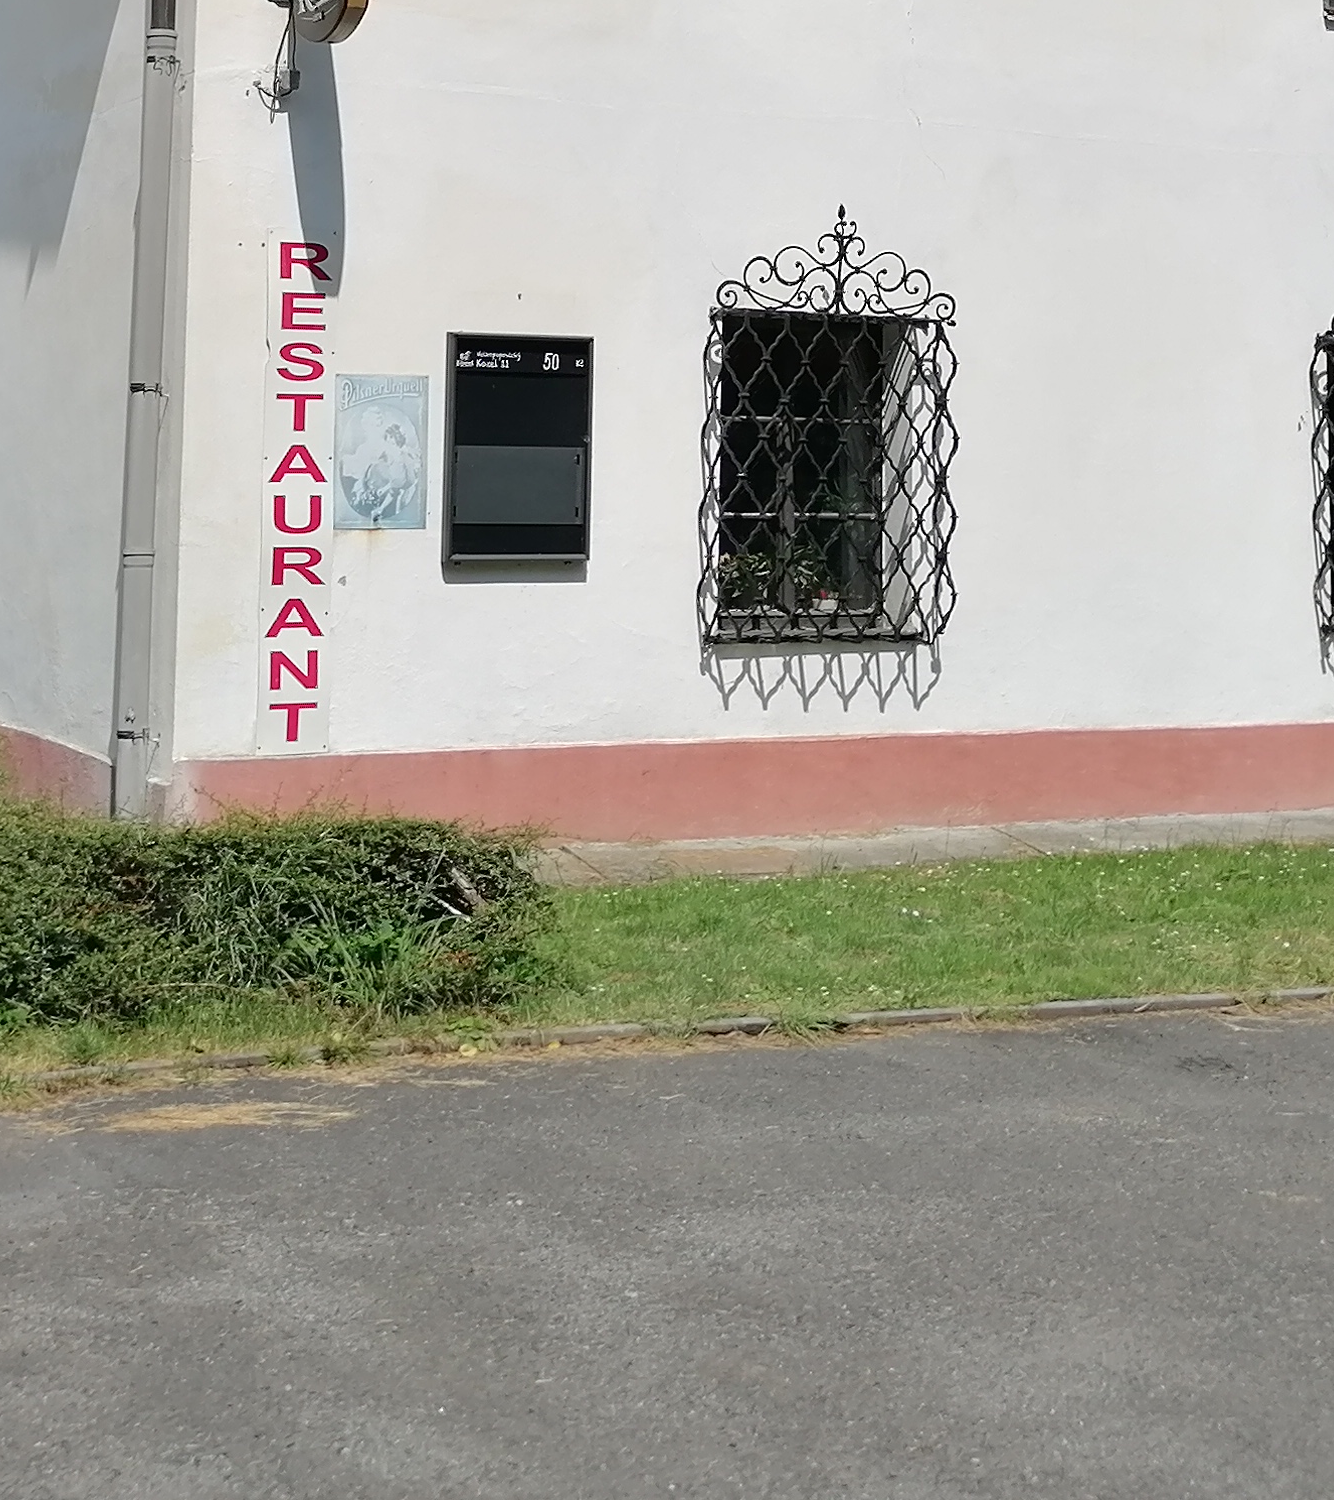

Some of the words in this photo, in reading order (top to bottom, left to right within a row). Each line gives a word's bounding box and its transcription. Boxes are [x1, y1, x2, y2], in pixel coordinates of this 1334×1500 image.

[542, 352, 560, 371] 50
[340, 378, 384, 409] Pilsner
[385, 378, 423, 400] Urquell
[264, 241, 331, 742] RESTAURANT
